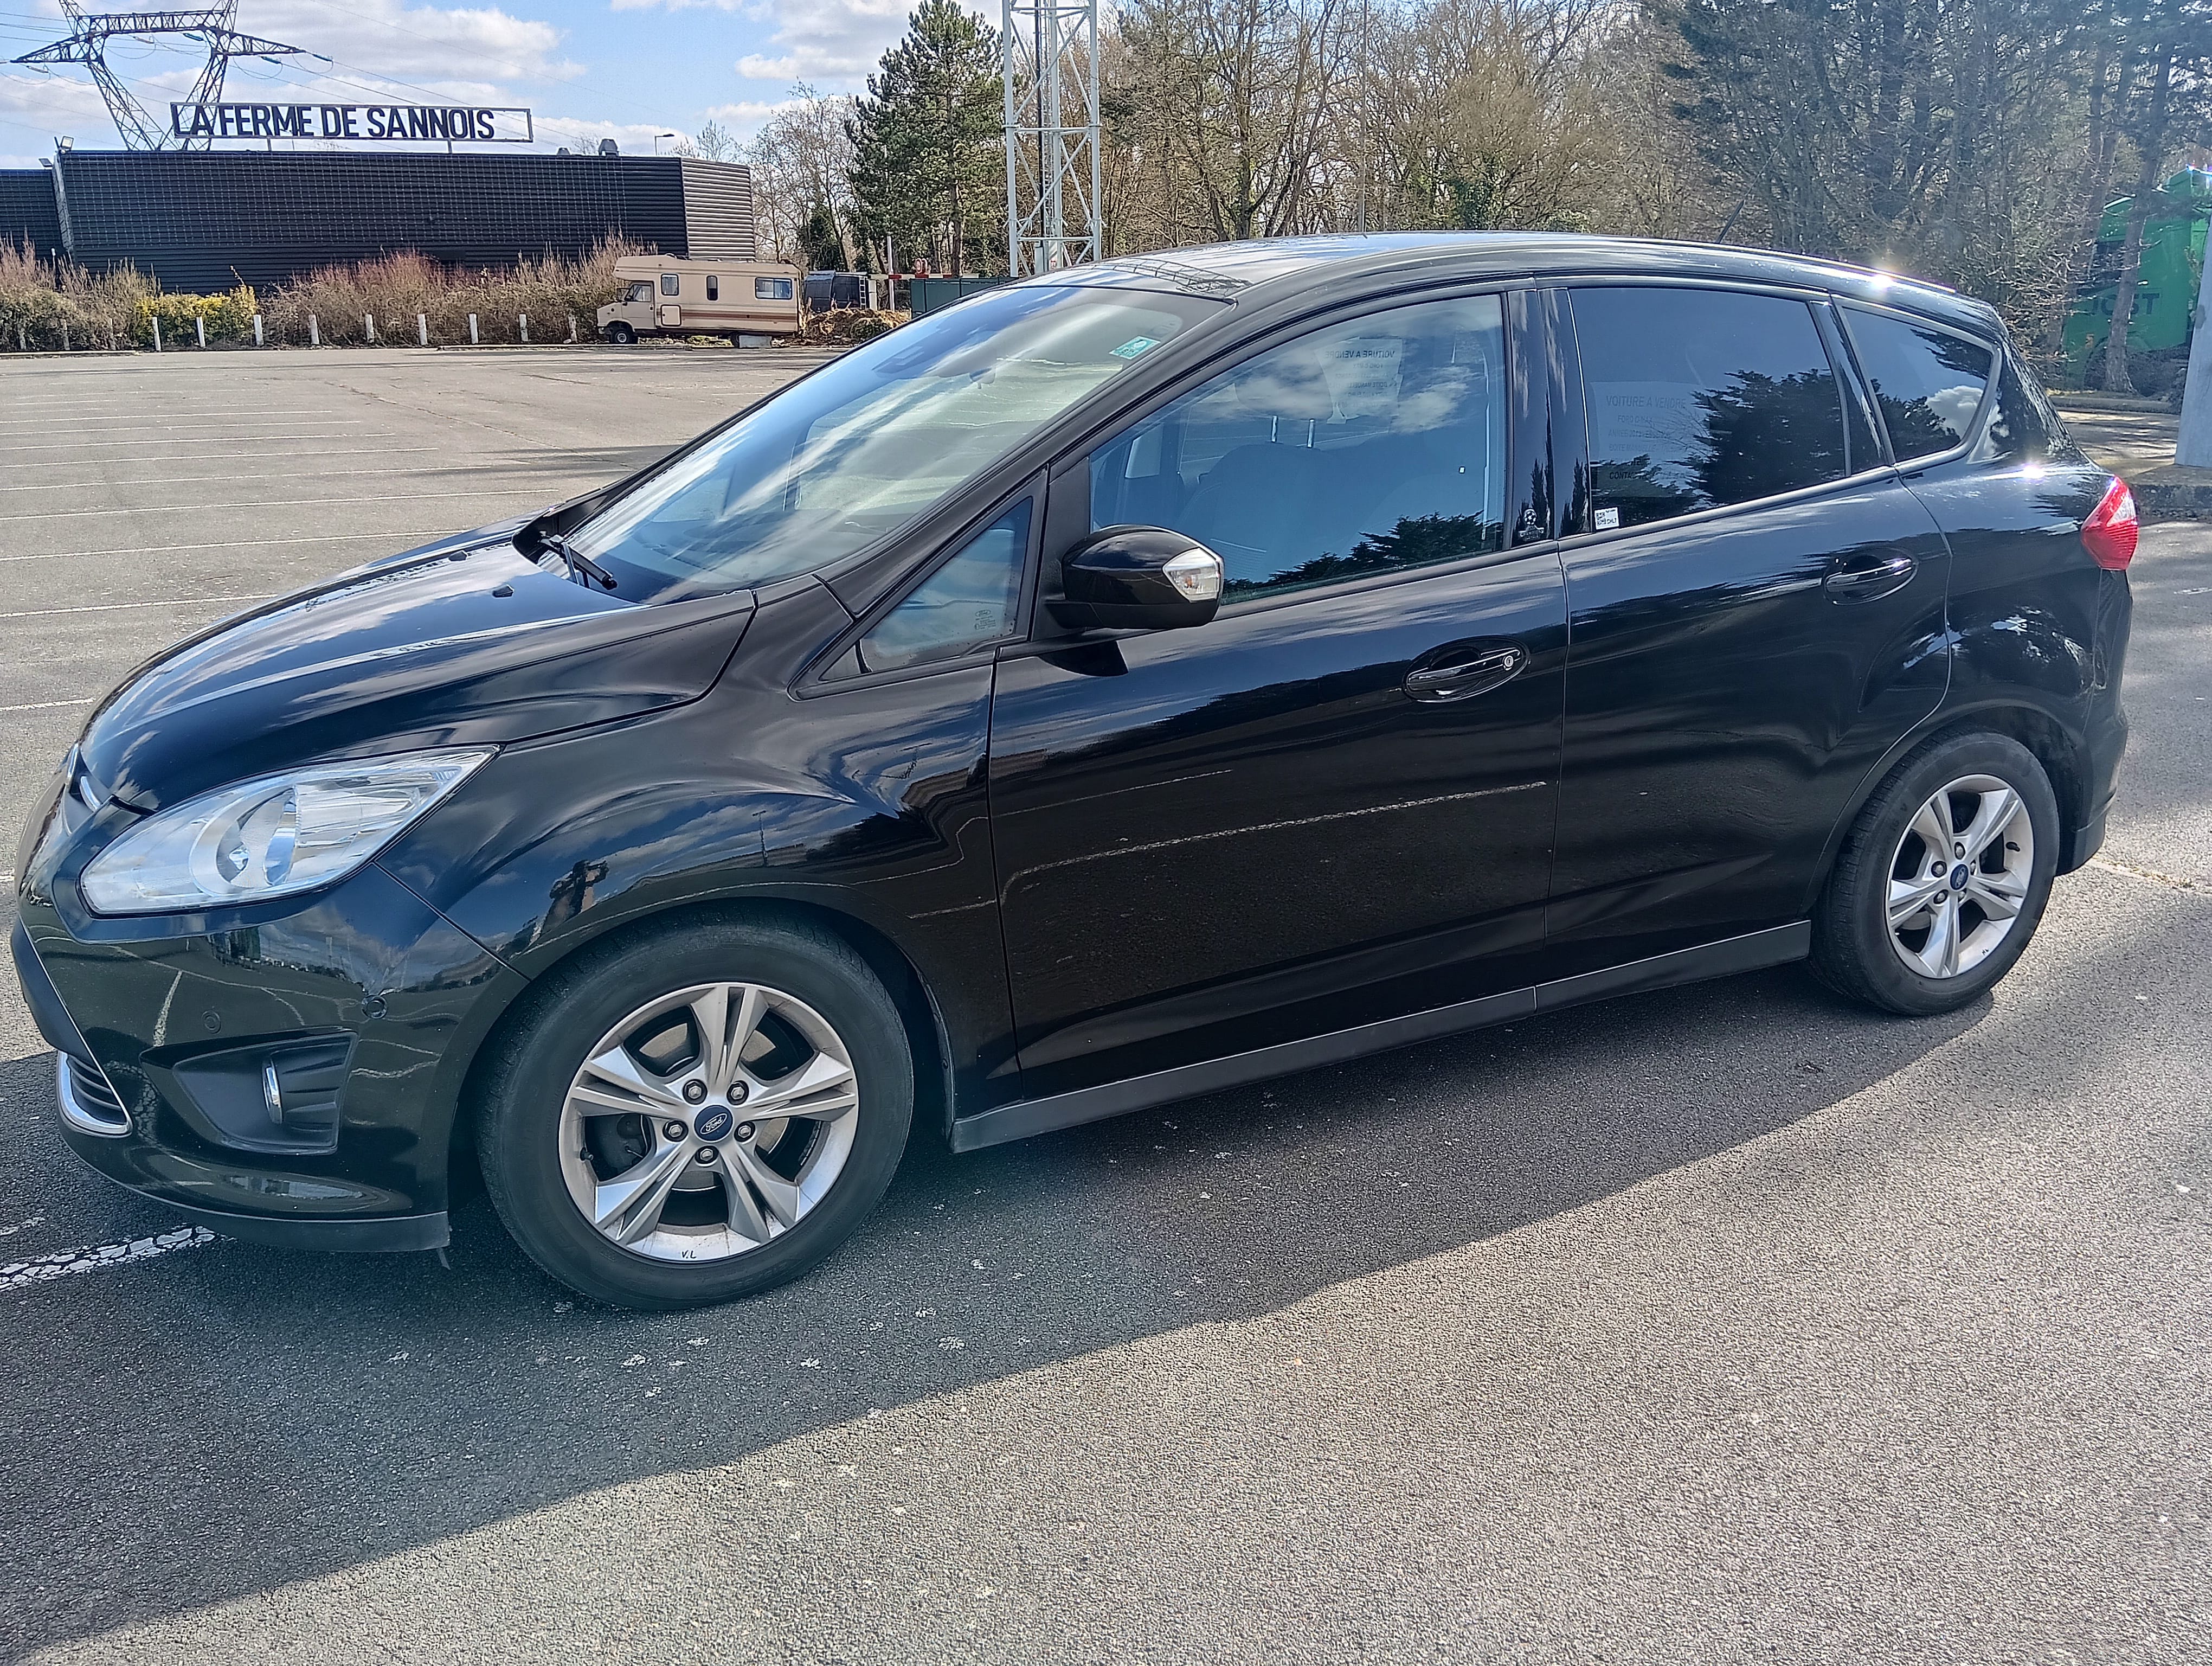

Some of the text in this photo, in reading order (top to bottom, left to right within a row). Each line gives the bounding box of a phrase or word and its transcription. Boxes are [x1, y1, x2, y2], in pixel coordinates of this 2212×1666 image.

[171, 105, 495, 139] LA FERME DE SANNOIS
[1606, 395, 1687, 408] VOITURE A VENDRE
[706, 1117, 723, 1131] Ford
